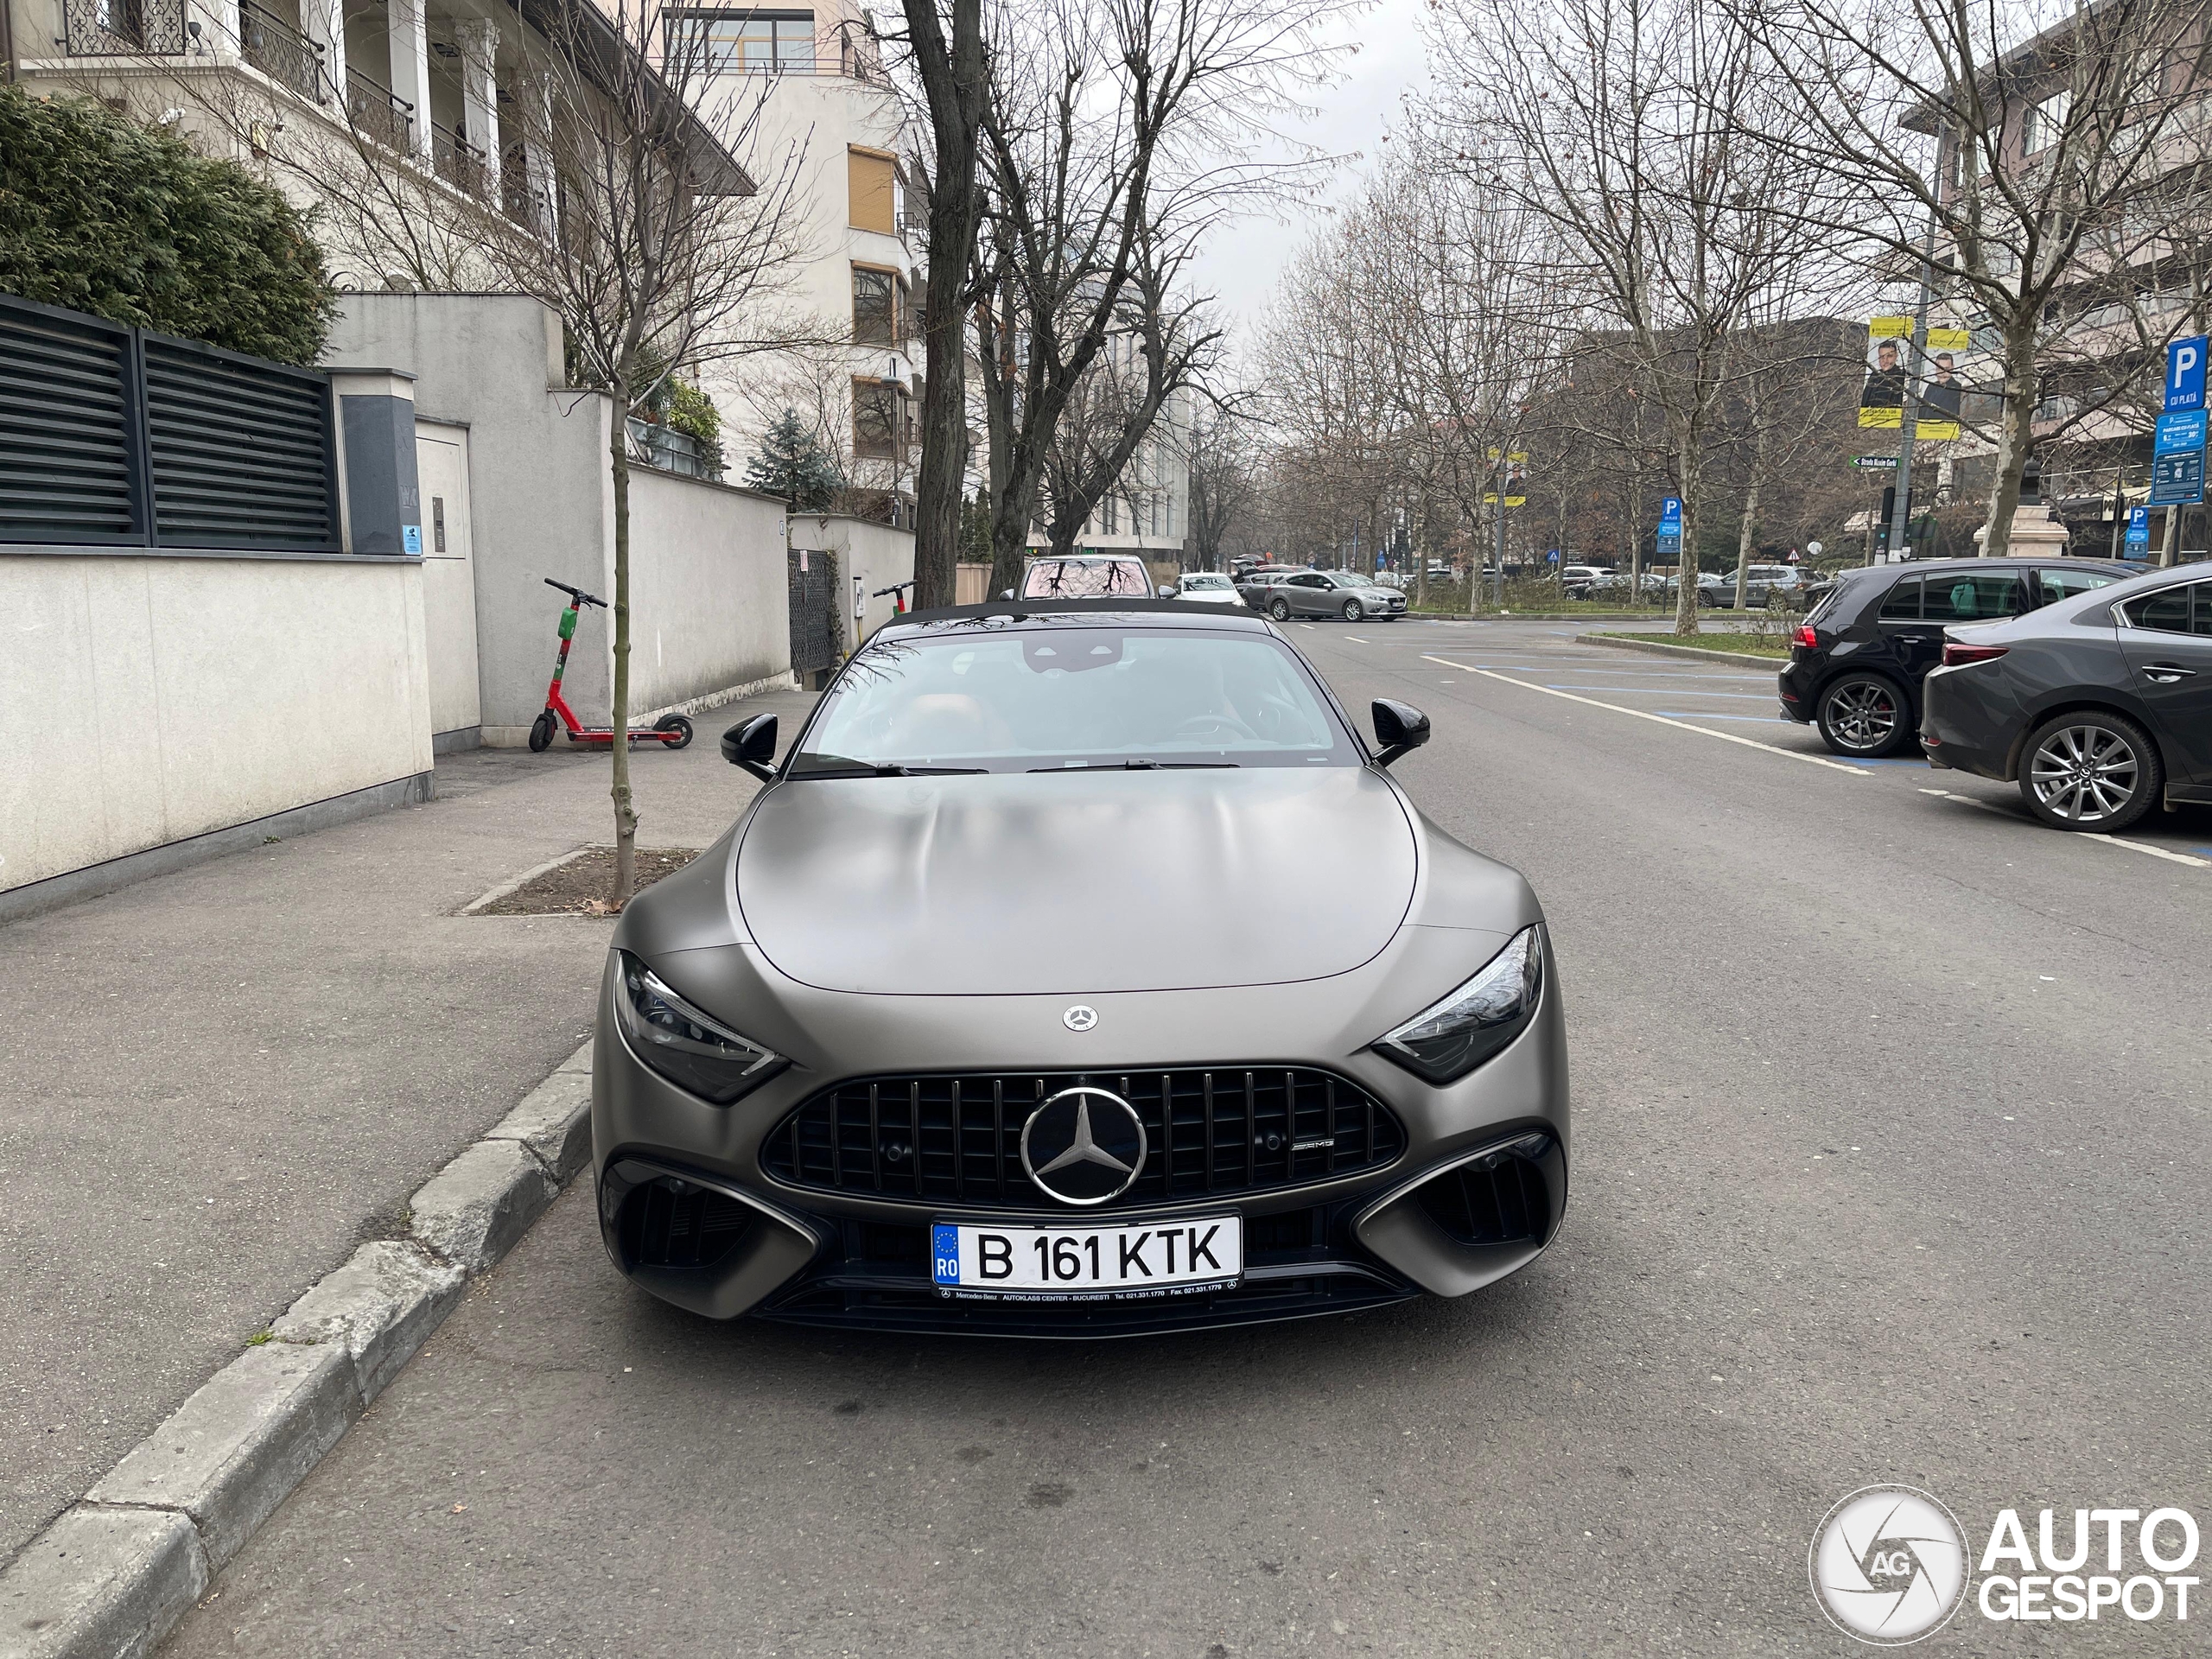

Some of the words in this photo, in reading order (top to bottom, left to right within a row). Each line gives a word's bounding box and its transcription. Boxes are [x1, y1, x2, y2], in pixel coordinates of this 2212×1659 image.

[2174, 346, 2197, 389] P
[2171, 395, 2179, 406] CU
[1666, 500, 1677, 515] P
[2133, 510, 2144, 523] P
[1306, 1140, 1335, 1149] AMG
[977, 1233, 1014, 1279] B
[1034, 1235, 1100, 1281] 161
[1119, 1225, 1222, 1279] KTK
[938, 1258, 957, 1277] RO
[956, 1291, 998, 1301] Mercedes-Benz
[1126, 1290, 1165, 1300] 021.331.1770
[1170, 1287, 1183, 1296] Fax.
